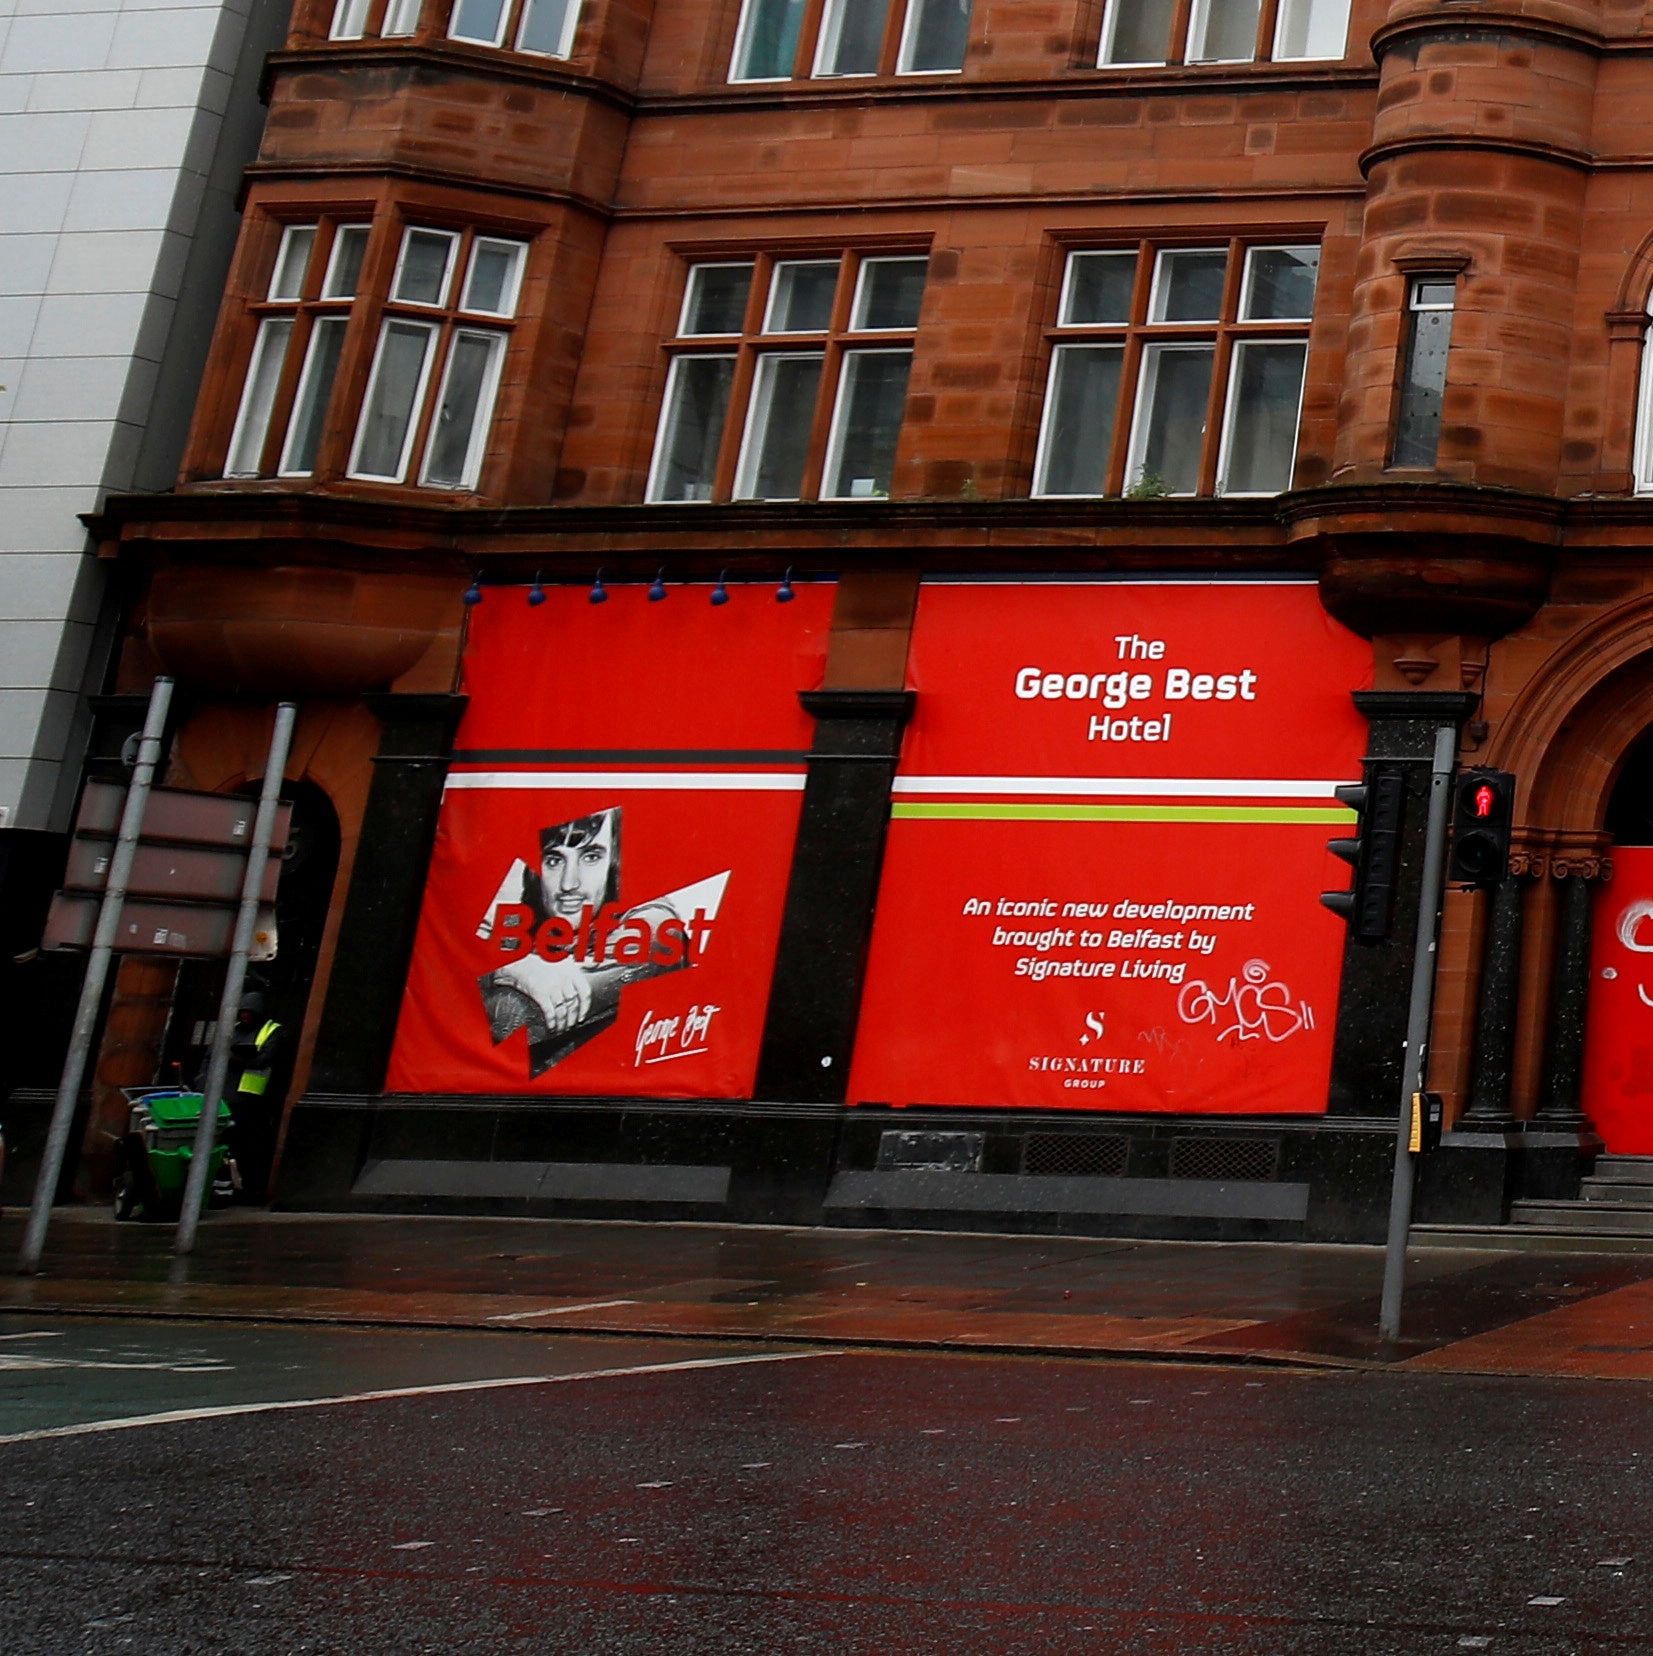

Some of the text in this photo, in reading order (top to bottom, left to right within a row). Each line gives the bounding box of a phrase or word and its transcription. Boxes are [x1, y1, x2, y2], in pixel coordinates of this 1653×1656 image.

[1114, 634, 1166, 660] The
[1015, 667, 1257, 709] George Best
[1088, 713, 1172, 742] Hotel
[962, 897, 1255, 925] An iconic new development
[491, 902, 717, 966] Belfast
[992, 926, 1217, 955] brought to Belfast by
[1014, 957, 1187, 984] Signature Living
[1028, 1056, 1145, 1074] SIGNATURE
[1063, 1078, 1106, 1089] GROUP
